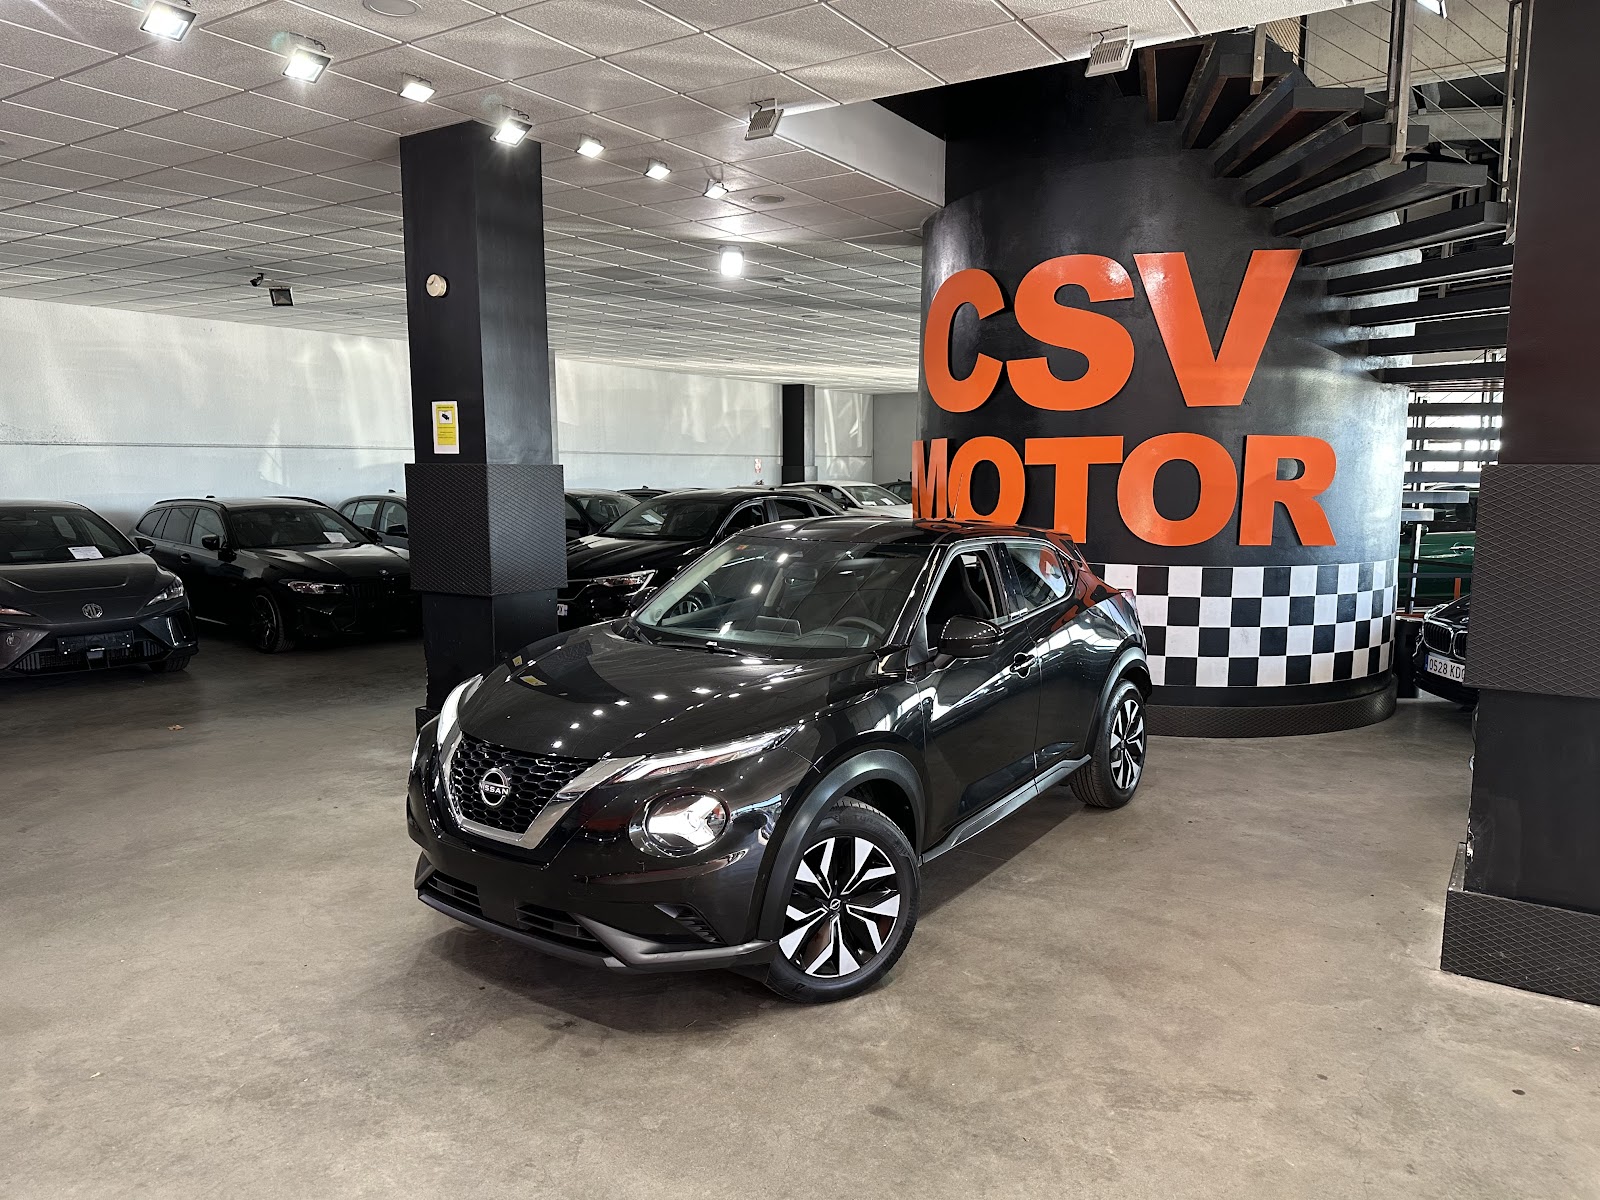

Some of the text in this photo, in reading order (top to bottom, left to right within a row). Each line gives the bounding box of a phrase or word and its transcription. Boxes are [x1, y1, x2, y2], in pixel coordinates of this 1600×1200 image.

[924, 249, 1302, 412] CSV
[912, 432, 1337, 546] MOTOR
[1429, 659, 1448, 675] 0528
[479, 782, 509, 795] NISSAN
